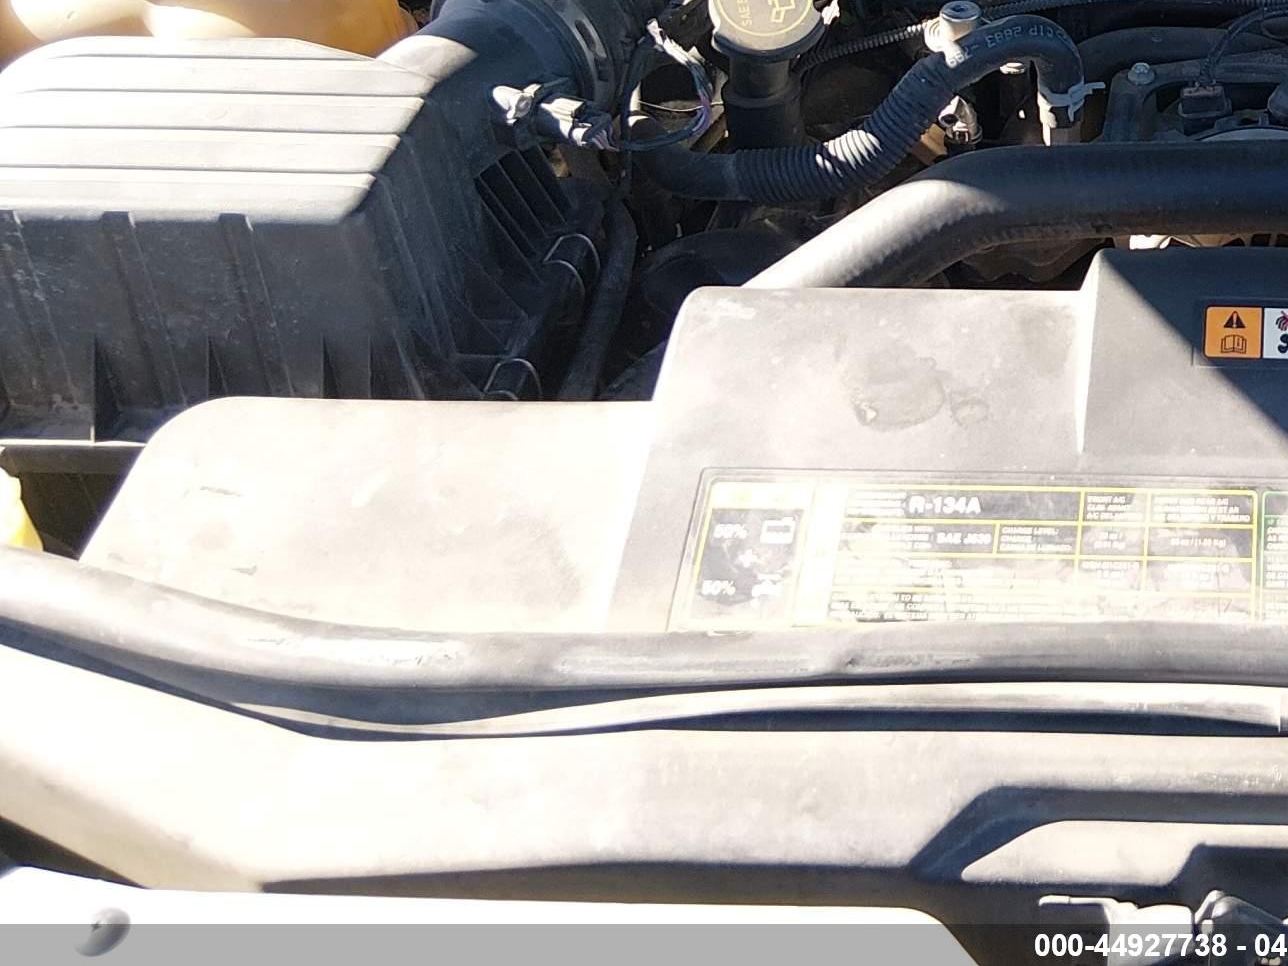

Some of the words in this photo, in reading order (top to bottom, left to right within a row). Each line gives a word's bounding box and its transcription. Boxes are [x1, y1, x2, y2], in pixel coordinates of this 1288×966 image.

[738, 5, 753, 26] SAE
[907, 494, 982, 516] R-134A
[936, 532, 962, 545] SAE
[701, 579, 736, 596] 50%
